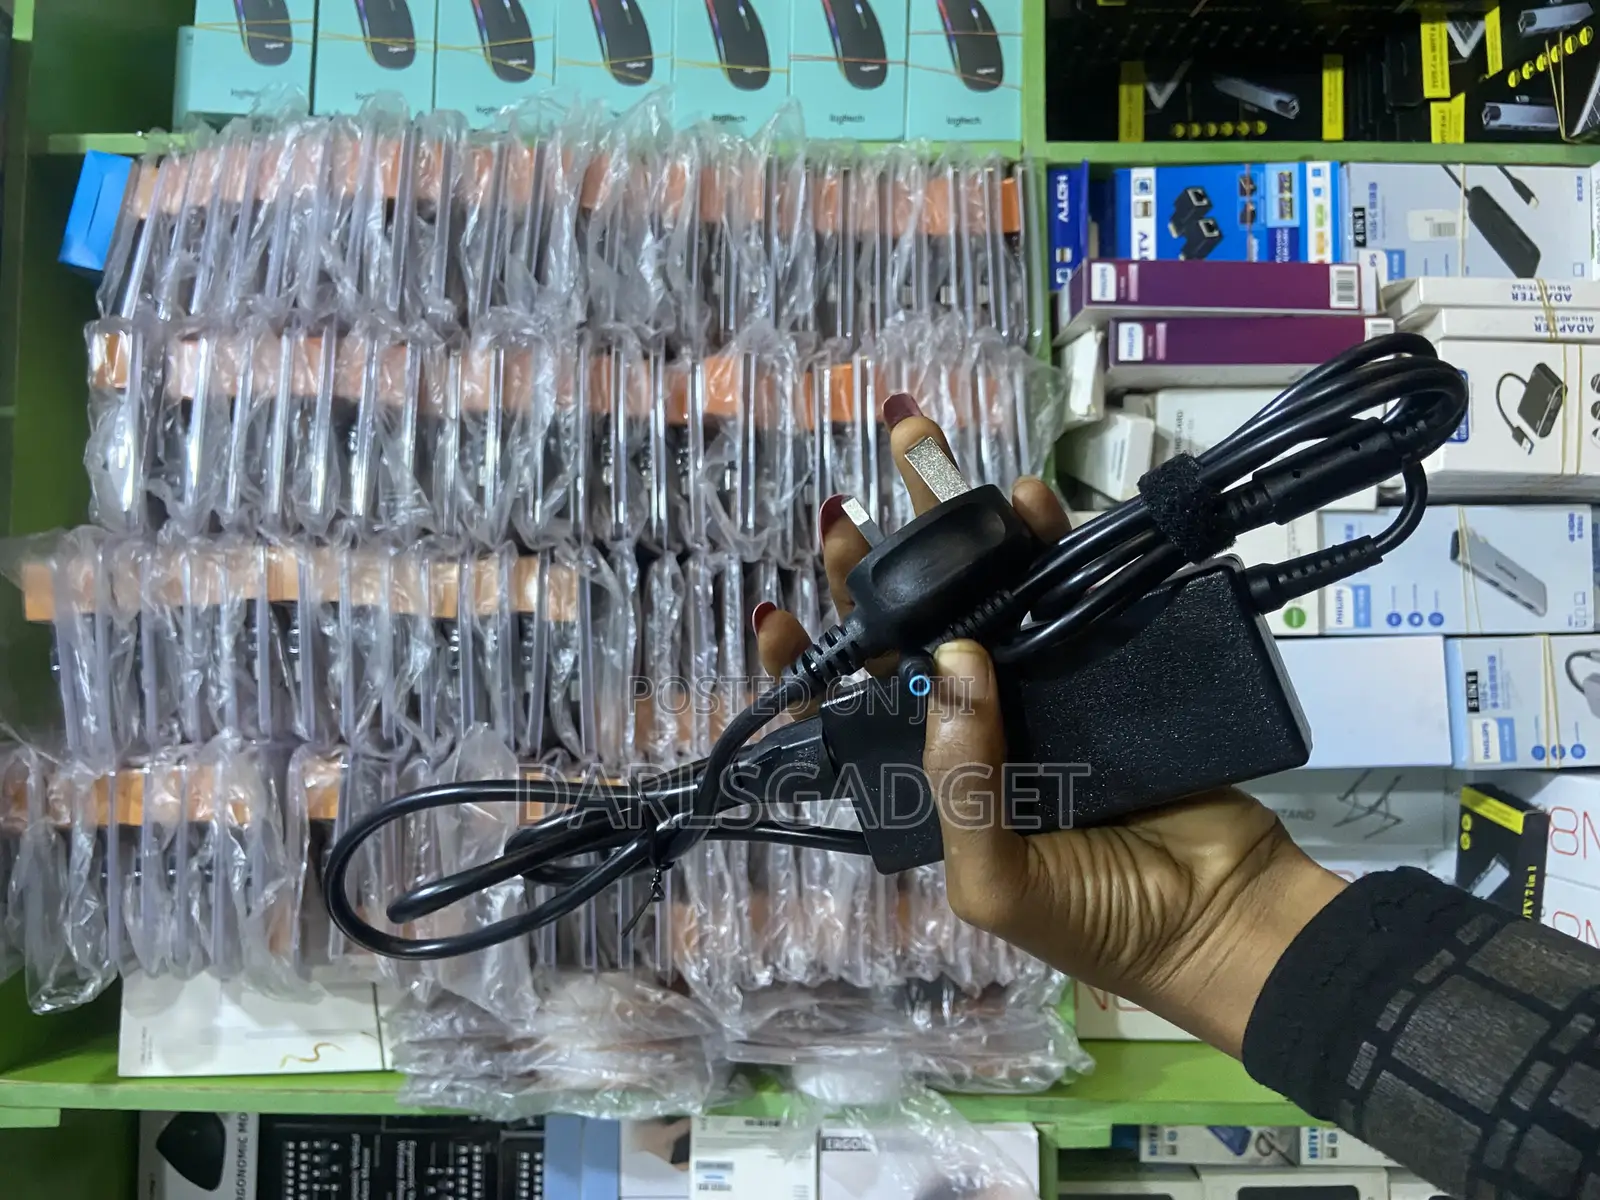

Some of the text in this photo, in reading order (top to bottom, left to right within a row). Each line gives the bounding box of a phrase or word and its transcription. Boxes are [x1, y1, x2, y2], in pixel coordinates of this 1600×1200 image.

[829, 113, 865, 125] logitech
[946, 115, 982, 127] logitech
[1056, 174, 1069, 223] HDTV
[1511, 292, 1573, 303] ADATER
[1534, 323, 1596, 334] ADAPER
